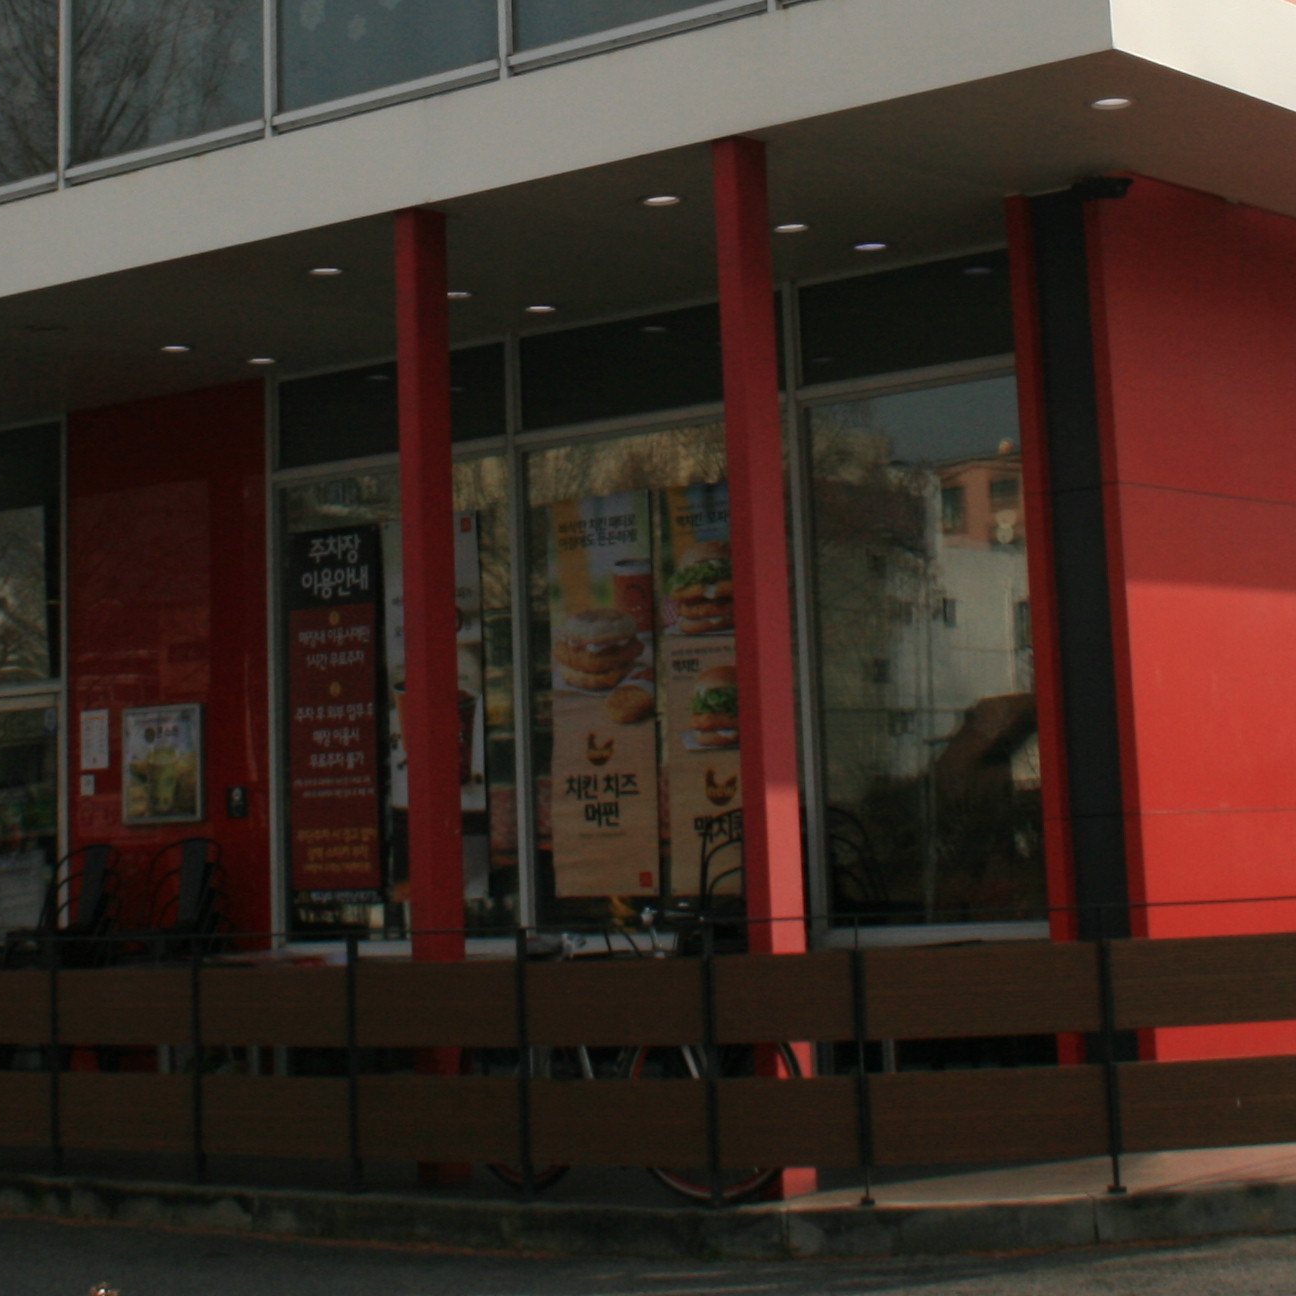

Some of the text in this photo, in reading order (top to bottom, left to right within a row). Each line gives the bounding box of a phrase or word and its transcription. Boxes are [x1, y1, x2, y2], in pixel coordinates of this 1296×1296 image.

[307, 533, 361, 564] 주차장
[301, 564, 370, 600] 이용안내
[329, 649, 365, 668] 무료주차
[565, 772, 640, 800] 치킨 치즈
[584, 801, 620, 828] 머핀
